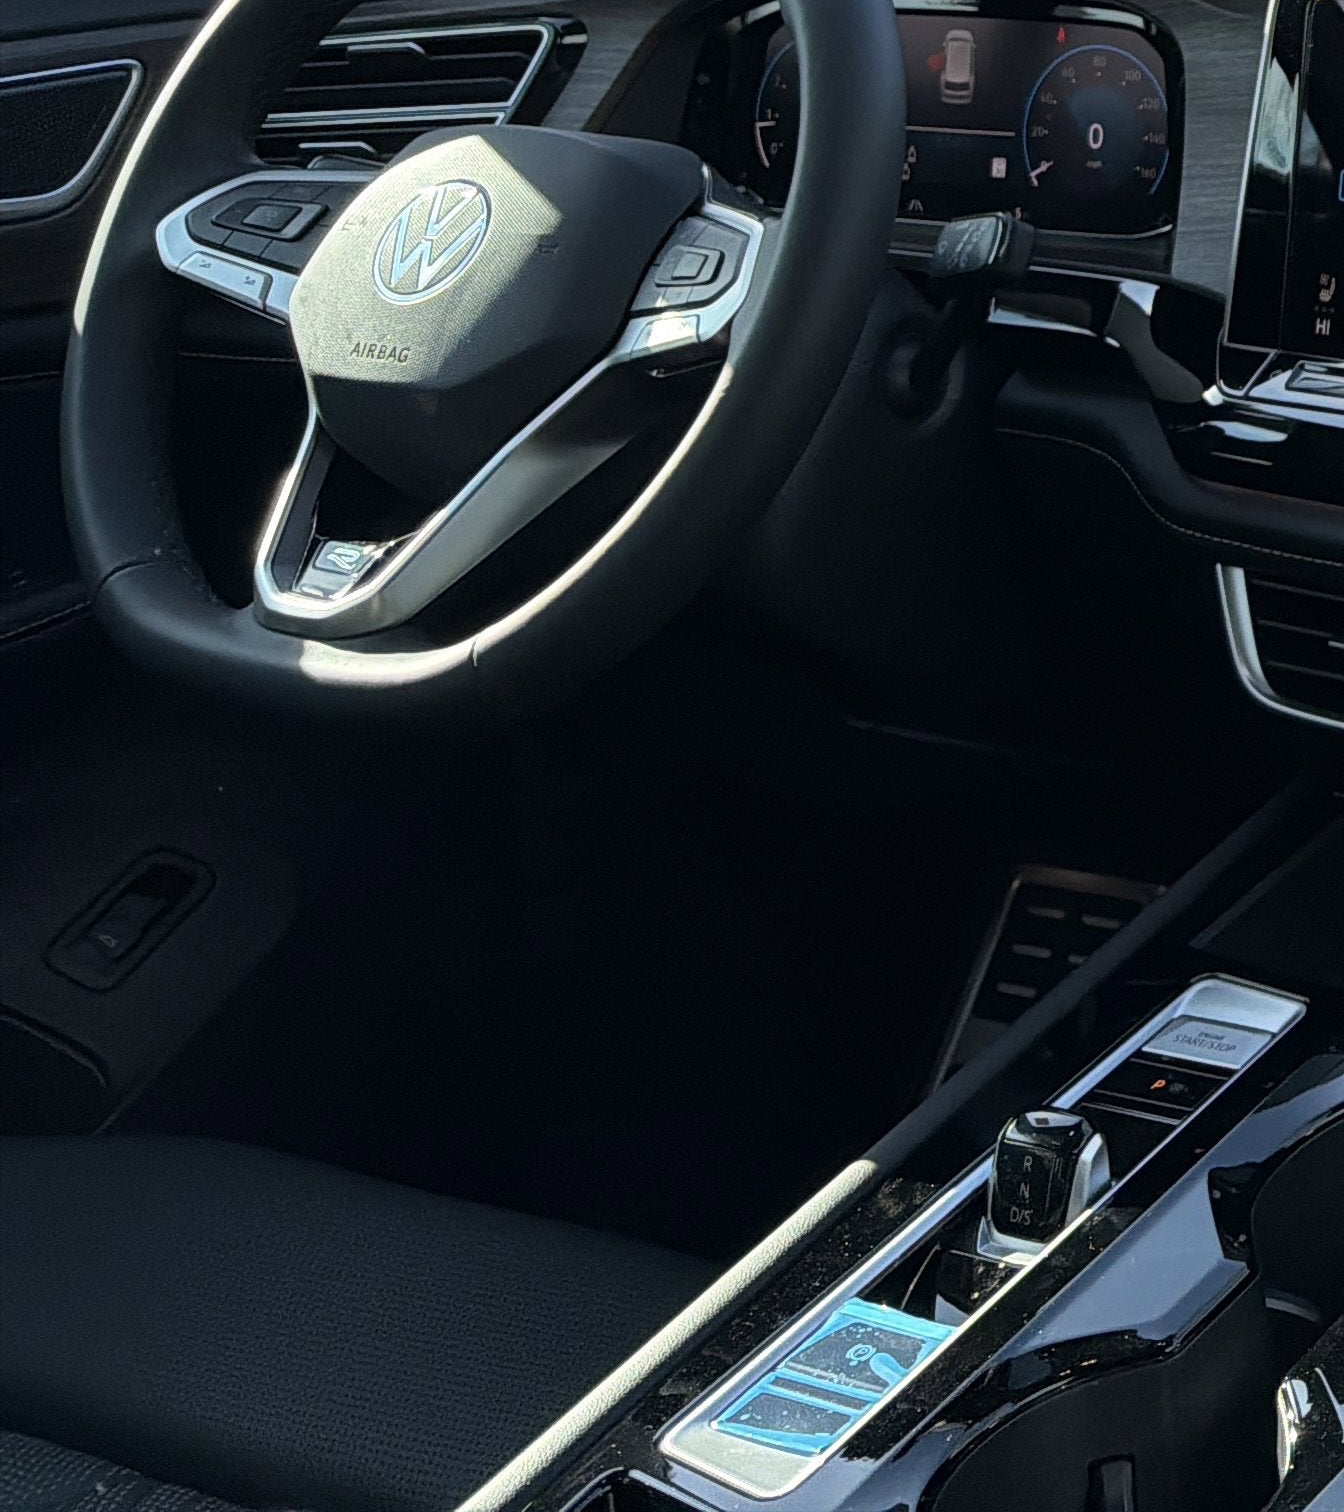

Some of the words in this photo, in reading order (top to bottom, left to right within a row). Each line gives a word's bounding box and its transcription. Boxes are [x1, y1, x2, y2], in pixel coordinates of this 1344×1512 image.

[1089, 123, 1104, 150] 0
[1315, 317, 1331, 336] HI
[350, 342, 411, 364] AIRBAG
[1174, 1033, 1238, 1053] START/STOP
[1022, 1155, 1034, 1172] R
[1019, 1182, 1031, 1198] N
